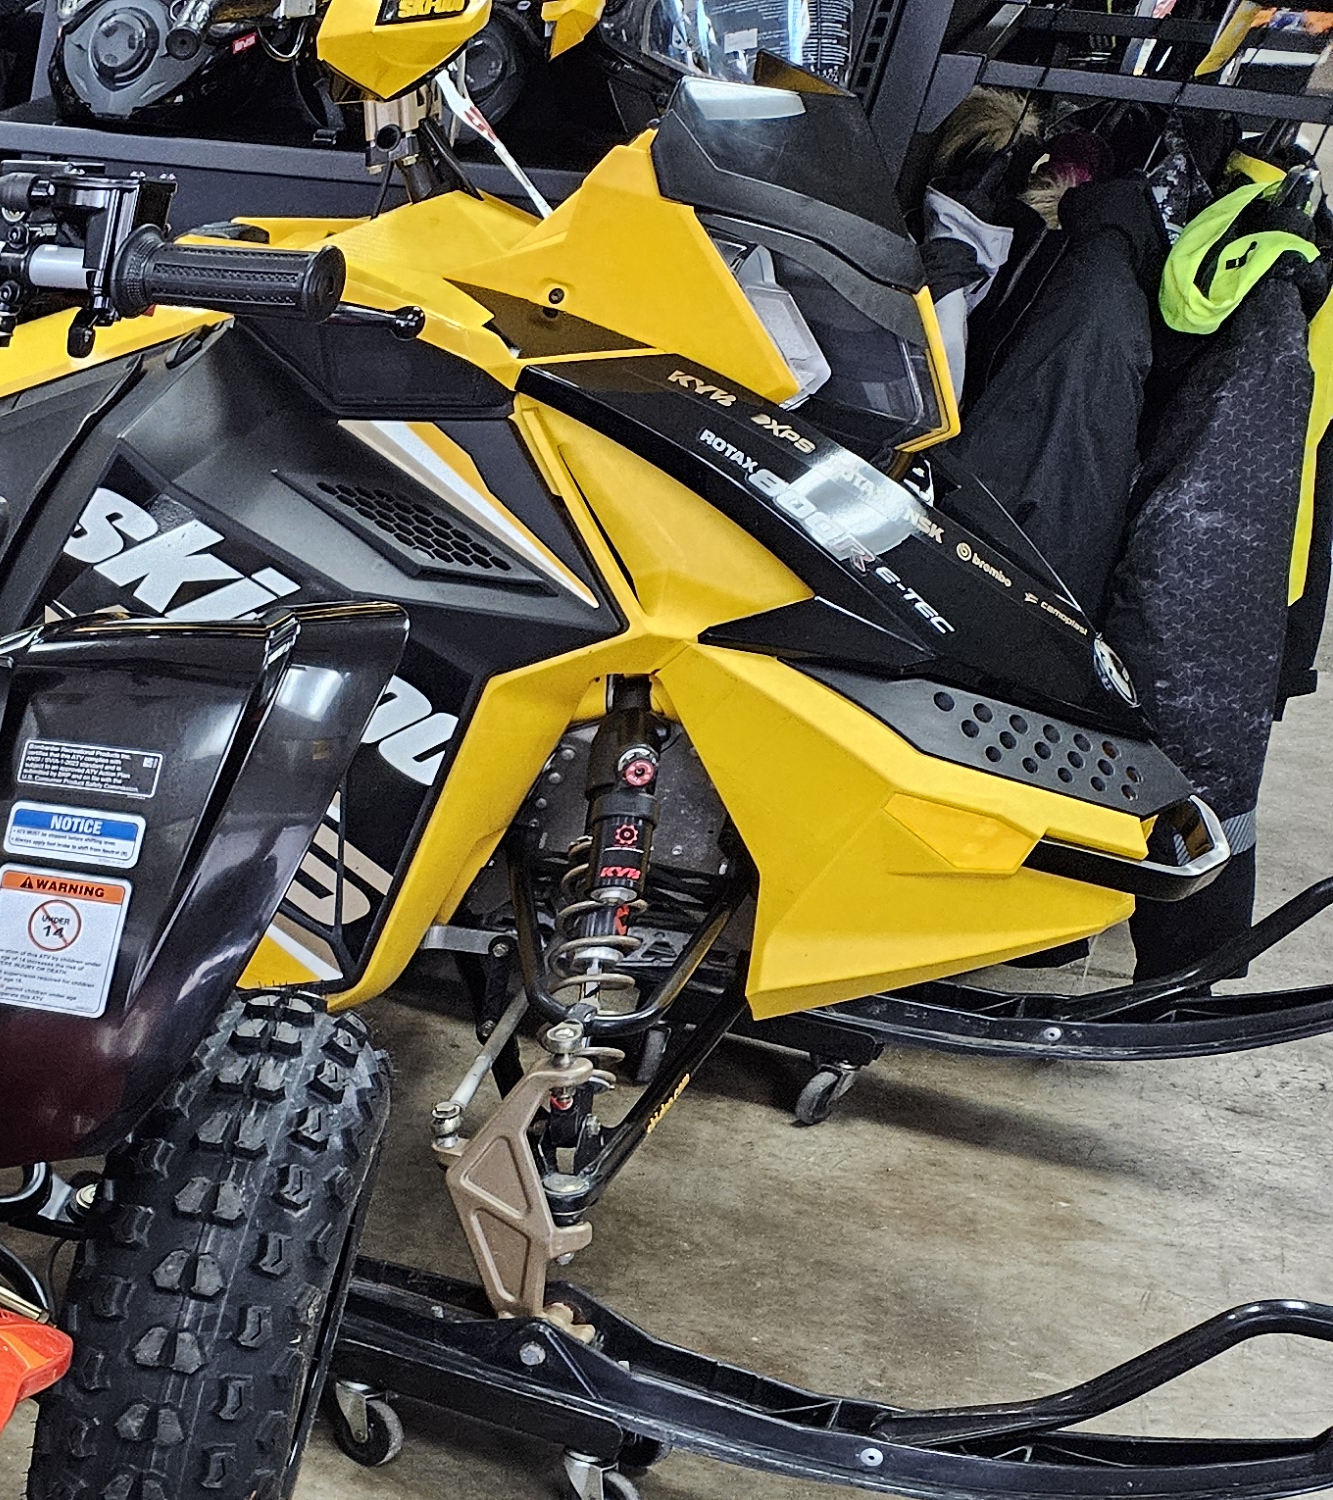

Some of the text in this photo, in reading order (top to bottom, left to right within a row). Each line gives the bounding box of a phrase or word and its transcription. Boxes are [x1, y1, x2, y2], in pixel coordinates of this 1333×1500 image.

[699, 428, 759, 473] ROTAX
[875, 566, 956, 635] E-TEC
[906, 508, 946, 544] NSK
[971, 553, 1013, 588] brembo
[50, 815, 103, 835] NOTICE
[37, 879, 105, 898] WARNING
[42, 915, 70, 926] UNDER
[43, 925, 65, 939] 14
[60, 956, 83, 964] children
